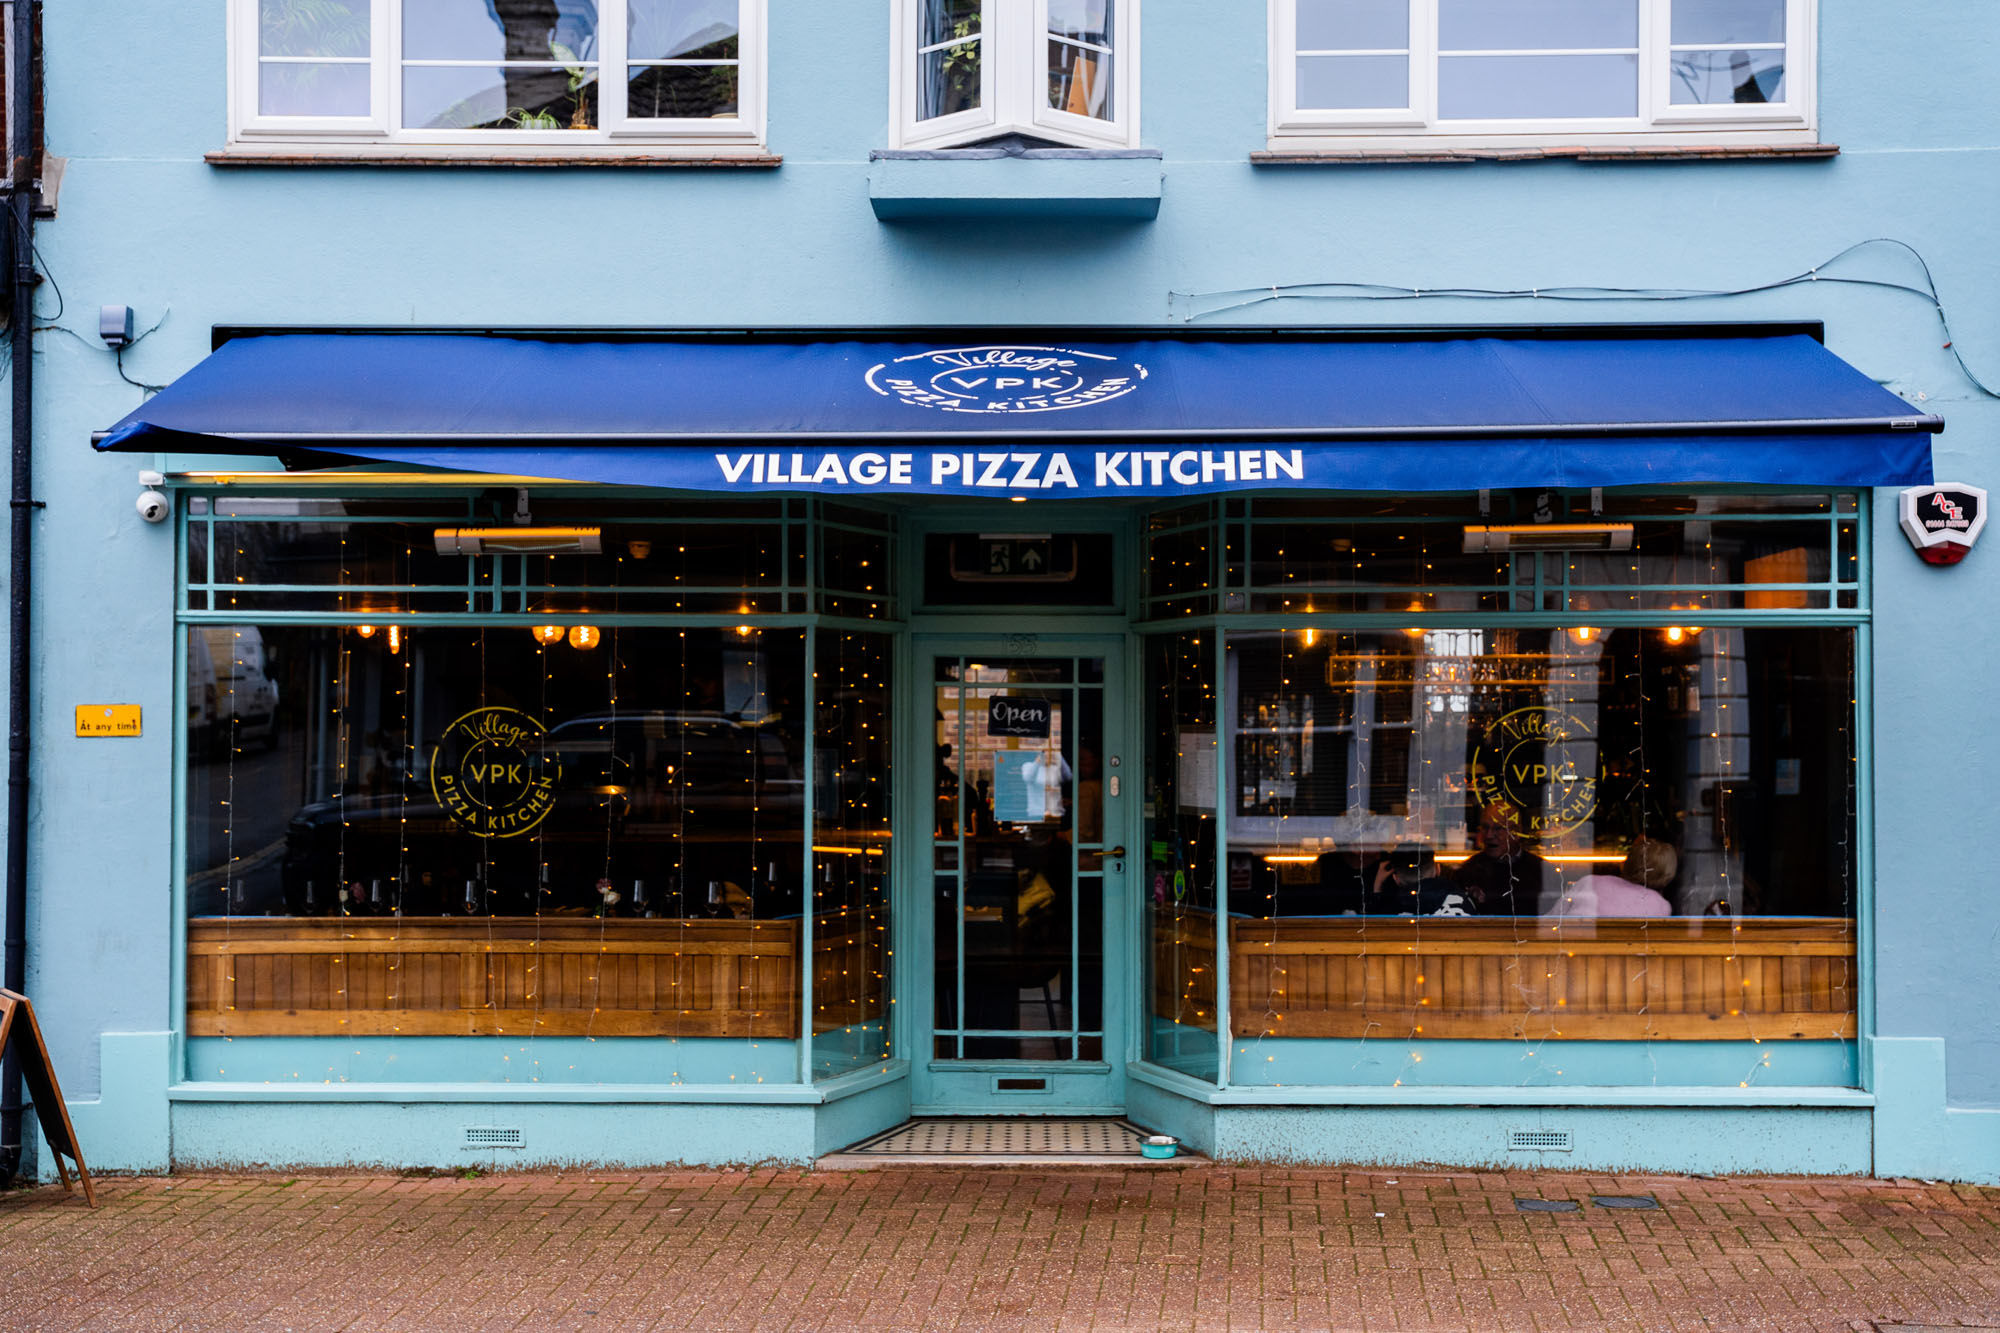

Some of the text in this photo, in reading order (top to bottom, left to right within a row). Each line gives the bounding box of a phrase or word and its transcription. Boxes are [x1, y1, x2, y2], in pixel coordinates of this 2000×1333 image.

[931, 350, 1077, 370] Village
[885, 377, 1130, 410] PIZZA KITCHEN
[950, 377, 1062, 389] VPK
[715, 449, 1303, 488] VILLAGE PIZZA KITCHEN
[1932, 493, 1963, 520] ACE
[80, 721, 137, 731] At any time
[992, 701, 1048, 726] Open
[460, 713, 529, 748] Village
[470, 764, 523, 784] VPK
[1512, 764, 1566, 784] VPK
[440, 775, 553, 829] PIZZA KITCHEN
[1482, 775, 1597, 830] PIZZA KITCHEN
